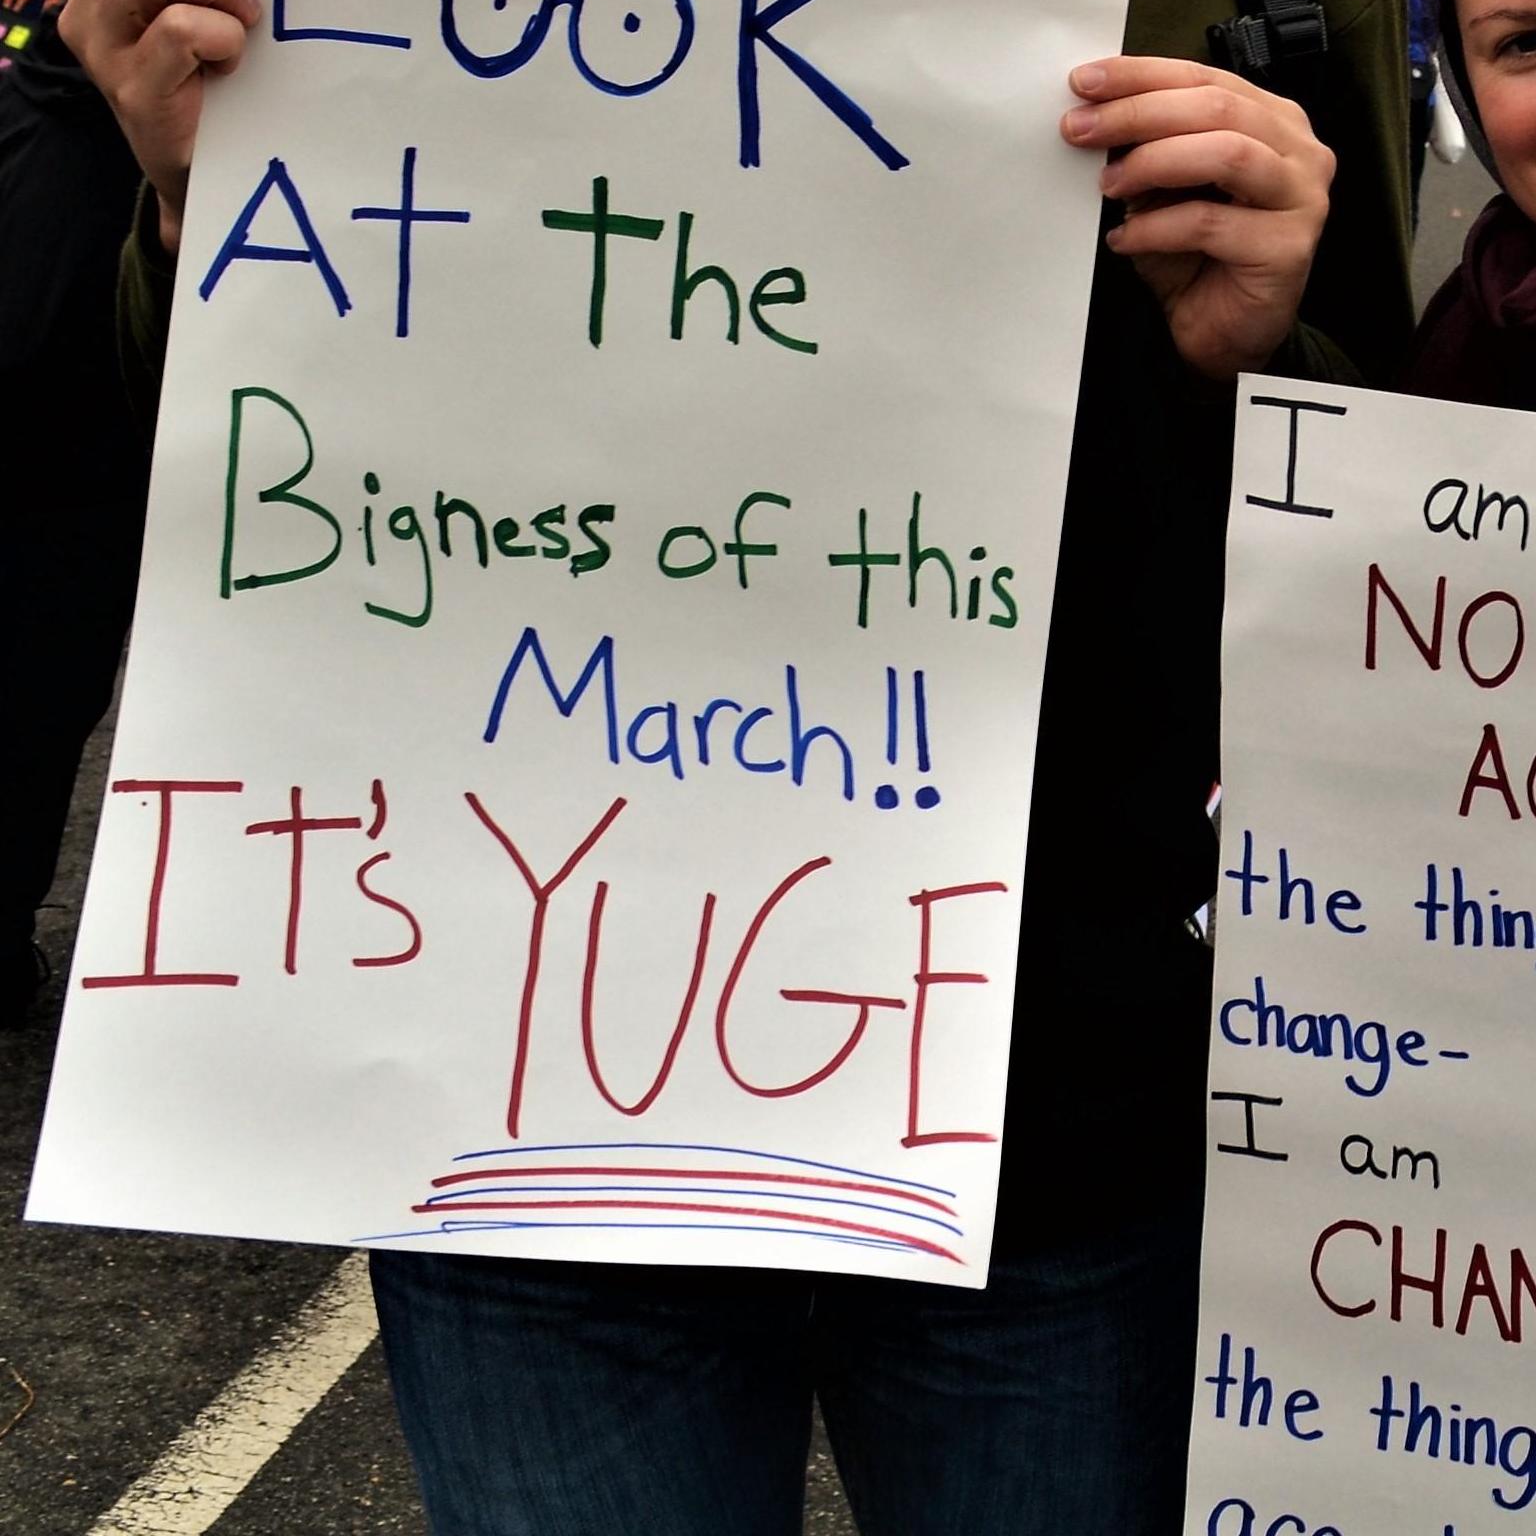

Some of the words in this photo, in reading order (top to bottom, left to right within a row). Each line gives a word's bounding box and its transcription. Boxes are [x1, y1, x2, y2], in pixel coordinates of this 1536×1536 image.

[200, 147, 470, 337] At
[541, 176, 819, 354] the
[221, 387, 616, 628] Bigness
[657, 491, 792, 589] of
[828, 492, 1019, 630] this
[1246, 396, 1347, 518] I
[1424, 479, 1530, 551] am
[1365, 563, 1525, 689] NO
[1225, 830, 1367, 934] the
[465, 793, 1008, 1149] YUGE
[1211, 1091, 1288, 1162] I
[1340, 1135, 1440, 1189] am
[1205, 1333, 1324, 1442] the
